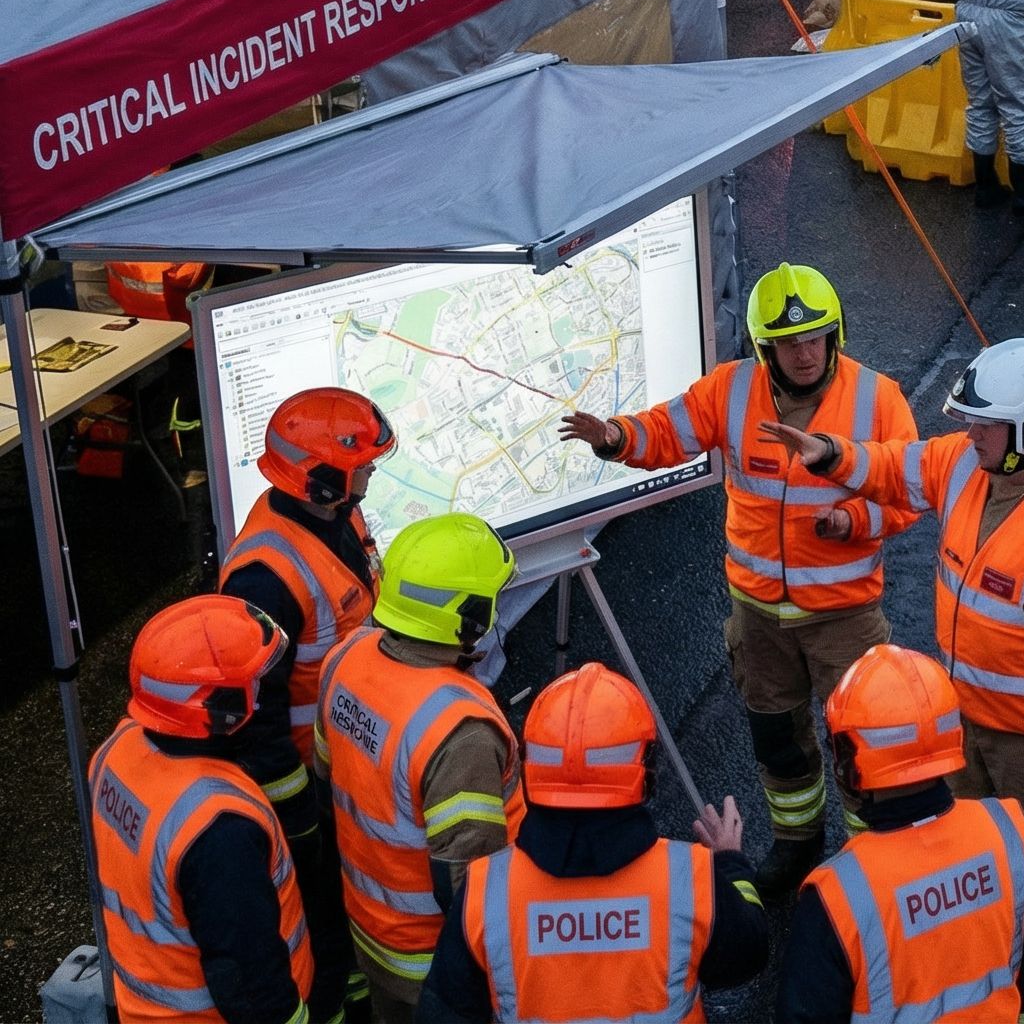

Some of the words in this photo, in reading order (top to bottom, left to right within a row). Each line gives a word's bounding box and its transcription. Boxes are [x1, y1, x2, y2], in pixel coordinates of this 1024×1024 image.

[33, 73, 187, 171] CRITICAL
[189, 10, 316, 105] INCIDENT
[101, 778, 141, 842] POLICE
[906, 864, 994, 925] POLICE
[537, 909, 641, 944] POLICE
